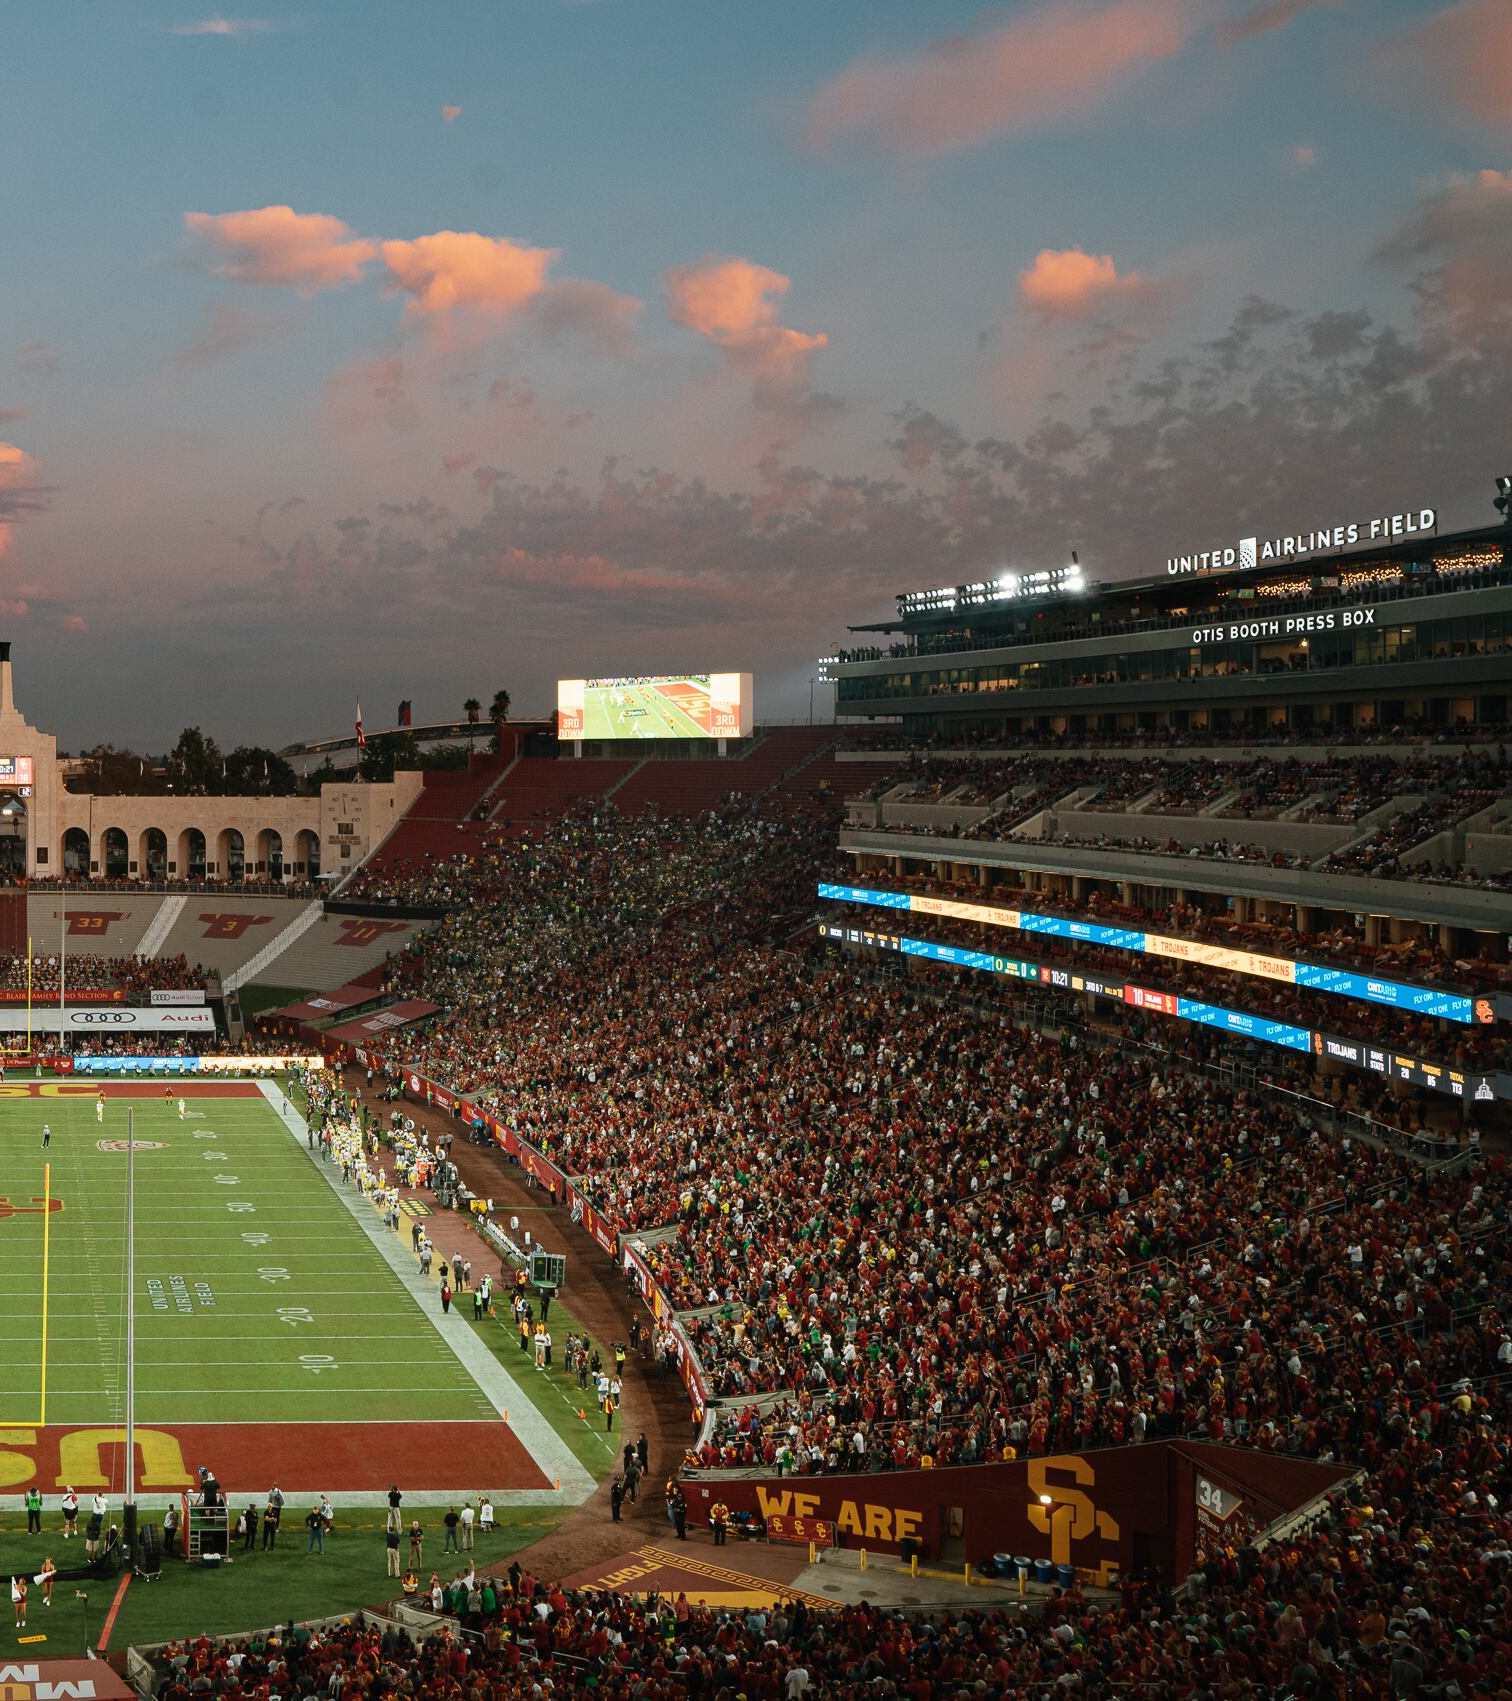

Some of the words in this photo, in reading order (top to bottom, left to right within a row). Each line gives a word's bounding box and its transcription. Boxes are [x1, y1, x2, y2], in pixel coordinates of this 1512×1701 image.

[1167, 548, 1236, 575] UNITED
[1261, 524, 1359, 559] AIRLINES
[1370, 509, 1435, 539] FIELD
[1193, 627, 1224, 644] OTIS
[1230, 621, 1279, 639] BOOTH
[1287, 614, 1335, 633] PRESS
[1343, 608, 1375, 626] BOX
[563, 718, 579, 729] 3RD
[715, 715, 735, 725] 3RD
[22, 788, 30, 796] 12
[77, 918, 103, 928] 33
[223, 921, 237, 931] 3
[354, 928, 378, 938] 11
[1161, 941, 1188, 956] TROJANS
[1259, 960, 1289, 977] TROJANS
[1051, 970, 1068, 986] 10:21
[1086, 981, 1095, 991] 3RD
[1367, 981, 1397, 997] ONTARIO
[55, 991, 76, 999] BND
[77, 990, 108, 999] SECTION
[1132, 988, 1143, 1005] 10
[1414, 995, 1424, 1004] FLY
[1452, 1001, 1462, 1010] FLY
[1475, 1000, 1493, 1024] SC
[161, 1014, 209, 1022] Audi
[1327, 1041, 1357, 1060] TROJANS
[1370, 1060, 1384, 1072] STATS
[1421, 1064, 1441, 1076] PASSING
[1449, 1071, 1464, 1084] TOTAL
[1452, 1082, 1463, 1095] 113
[227, 1202, 256, 1213] 50
[241, 1232, 272, 1244] 40
[257, 1267, 291, 1281] 30
[146, 1279, 169, 1310] UNITED
[168, 1275, 194, 1313] AIRLINES
[193, 1282, 216, 1306] FIELD
[276, 1307, 314, 1323] 20
[298, 1354, 339, 1370] 10
[1200, 1480, 1223, 1514] 34
[756, 1486, 821, 1521] WE
[838, 1500, 923, 1543] ARE
[1027, 1455, 1120, 1587] SC
[773, 1518, 783, 1532] SC
[794, 1520, 804, 1535] SC
[816, 1523, 826, 1538] SC
[598, 1560, 664, 1589] FIGHT
